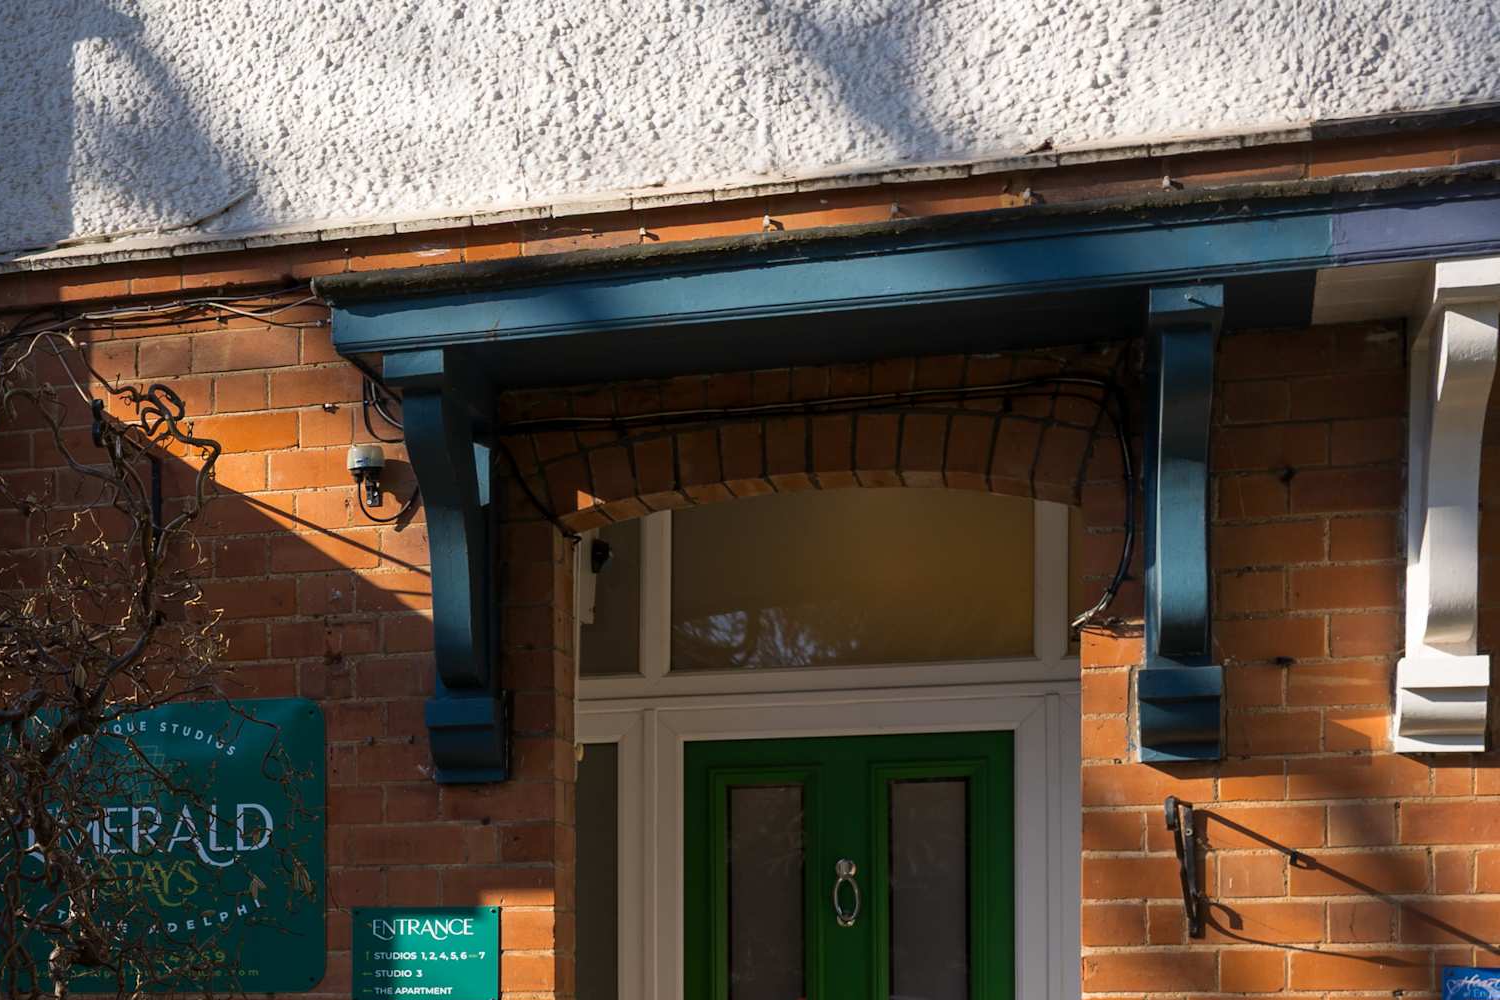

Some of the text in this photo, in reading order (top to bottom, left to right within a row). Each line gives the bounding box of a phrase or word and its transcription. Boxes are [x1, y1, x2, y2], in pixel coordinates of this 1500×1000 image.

[159, 721, 237, 756] STUDIOS
[372, 918, 475, 941] ENTRANCE
[374, 951, 417, 960] STUDIOS
[460, 951, 468, 960] 6
[478, 951, 486, 960] 7
[374, 969, 423, 978] STUDIO 3
[374, 987, 453, 995] THE APARTMENT
